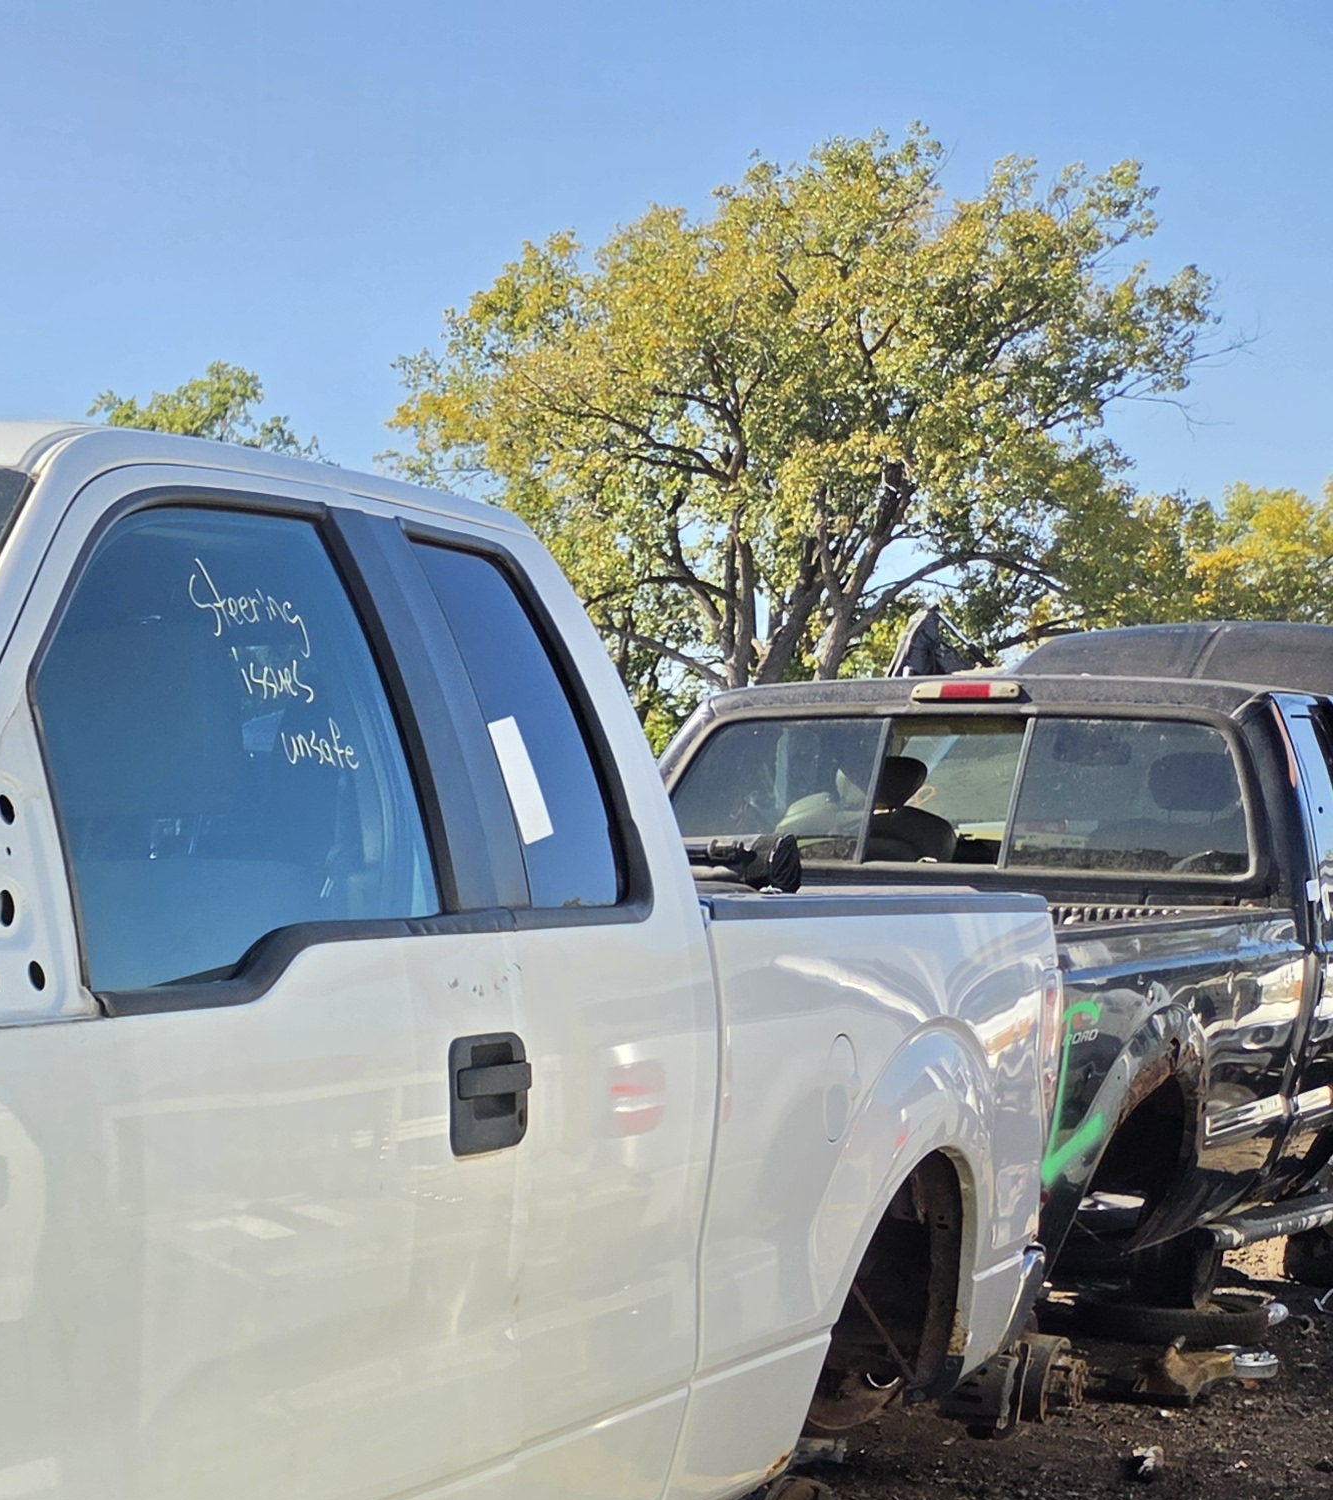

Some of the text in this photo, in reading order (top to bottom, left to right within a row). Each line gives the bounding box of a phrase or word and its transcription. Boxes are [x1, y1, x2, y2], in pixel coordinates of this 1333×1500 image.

[189, 557, 310, 658] Steering
[232, 646, 314, 703] issues
[281, 717, 359, 769] unsafe
